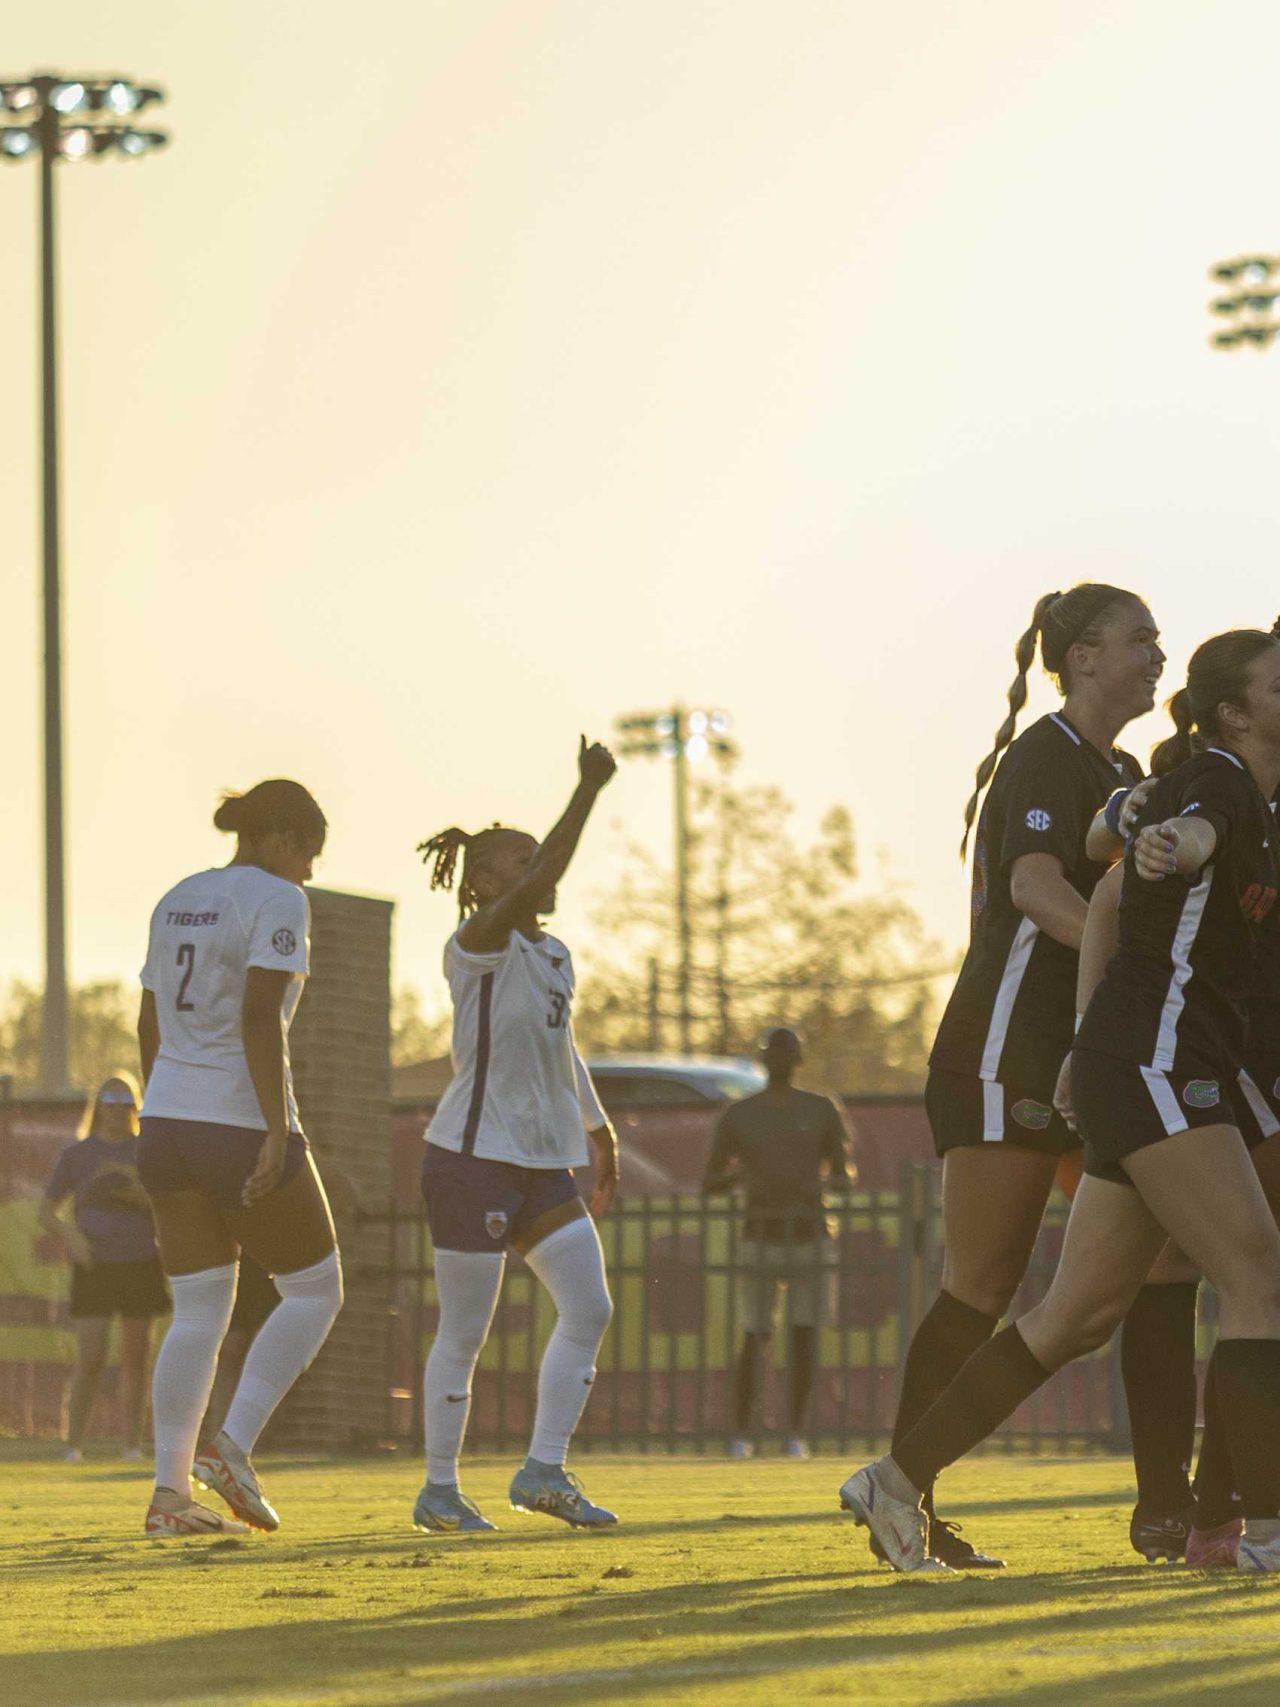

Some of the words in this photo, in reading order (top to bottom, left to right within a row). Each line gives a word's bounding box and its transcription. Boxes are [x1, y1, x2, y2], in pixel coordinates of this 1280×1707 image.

[1026, 809, 1051, 831] SEC
[166, 911, 220, 927] TIGERS
[175, 943, 196, 1012] 2
